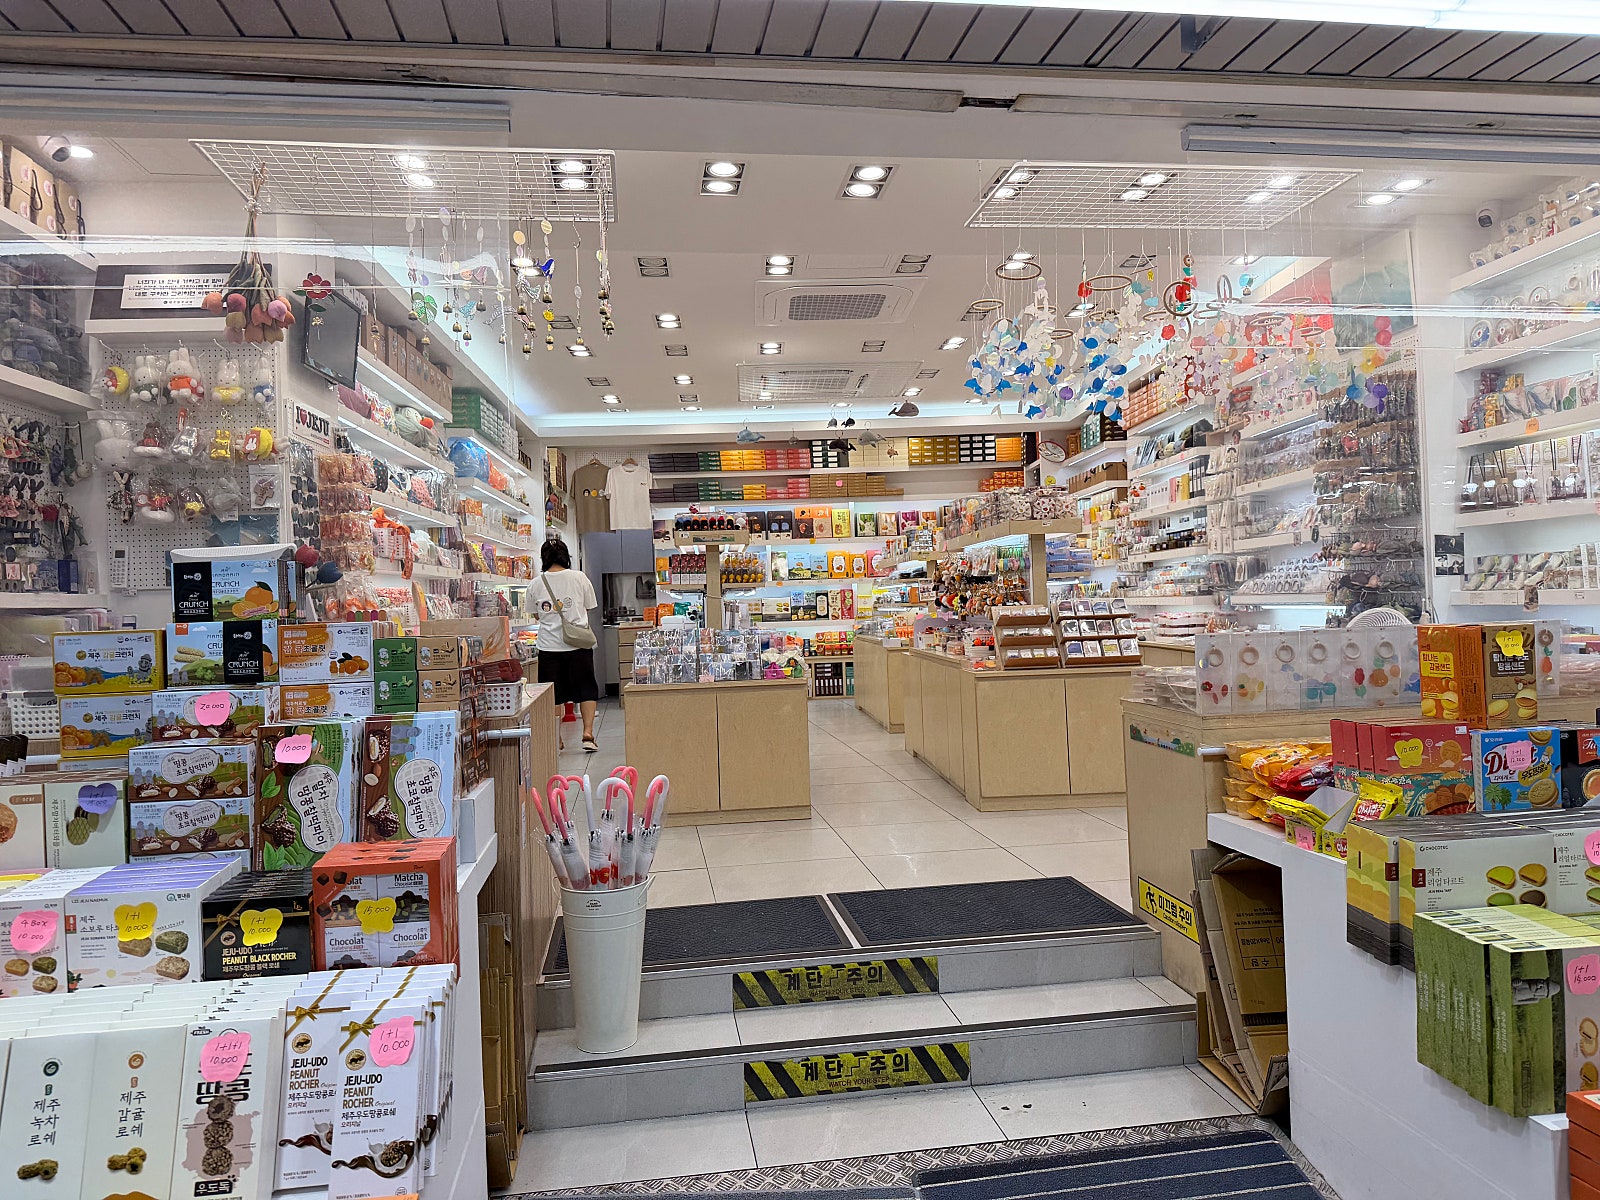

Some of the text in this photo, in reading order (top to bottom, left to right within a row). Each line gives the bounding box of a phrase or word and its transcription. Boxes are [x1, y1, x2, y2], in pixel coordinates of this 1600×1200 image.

[179, 600, 208, 608] CRUNCH
[88, 652, 100, 660] 제주
[228, 660, 259, 668] CRUNCH
[418, 775, 433, 794] 땅콩
[406, 780, 428, 833] 초코찰떡파이
[297, 785, 327, 846] 땅콩찰떡파이
[394, 874, 424, 882] Matcha
[1428, 868, 1442, 876] 제주
[1159, 895, 1192, 927] 미끄럼 주의
[80, 924, 104, 933] 소보루
[330, 937, 364, 947] Chocolat
[393, 932, 428, 942] Chocolat
[222, 947, 252, 956] JEJU-UDO
[223, 952, 297, 965] PEANUT BLACK ROCHER
[1574, 964, 1588, 974] 1+1
[784, 966, 882, 990] 계단 주의
[380, 1028, 398, 1039] 1+1
[215, 1041, 242, 1051] 1+1+1
[291, 1056, 328, 1068] JEJU-UDO
[801, 1053, 909, 1081] 계단 주의
[290, 1068, 320, 1079] PEANUT
[289, 1079, 320, 1090] ROCHER
[344, 1074, 382, 1086] JEJU-UDO
[829, 1080, 852, 1088] WATCH
[873, 1076, 890, 1084] STEP
[120, 1091, 147, 1105] 제주
[288, 1089, 336, 1101] 제주우도땅콩로
[344, 1086, 374, 1098] PEANUT
[33, 1098, 61, 1113] 제주
[343, 1098, 373, 1109] ROCHER
[118, 1108, 145, 1122] 감귤
[30, 1115, 59, 1130] 녹차
[116, 1123, 143, 1138] 로쉐
[28, 1131, 56, 1147] 로쉐
[196, 1182, 230, 1194] 우도독
